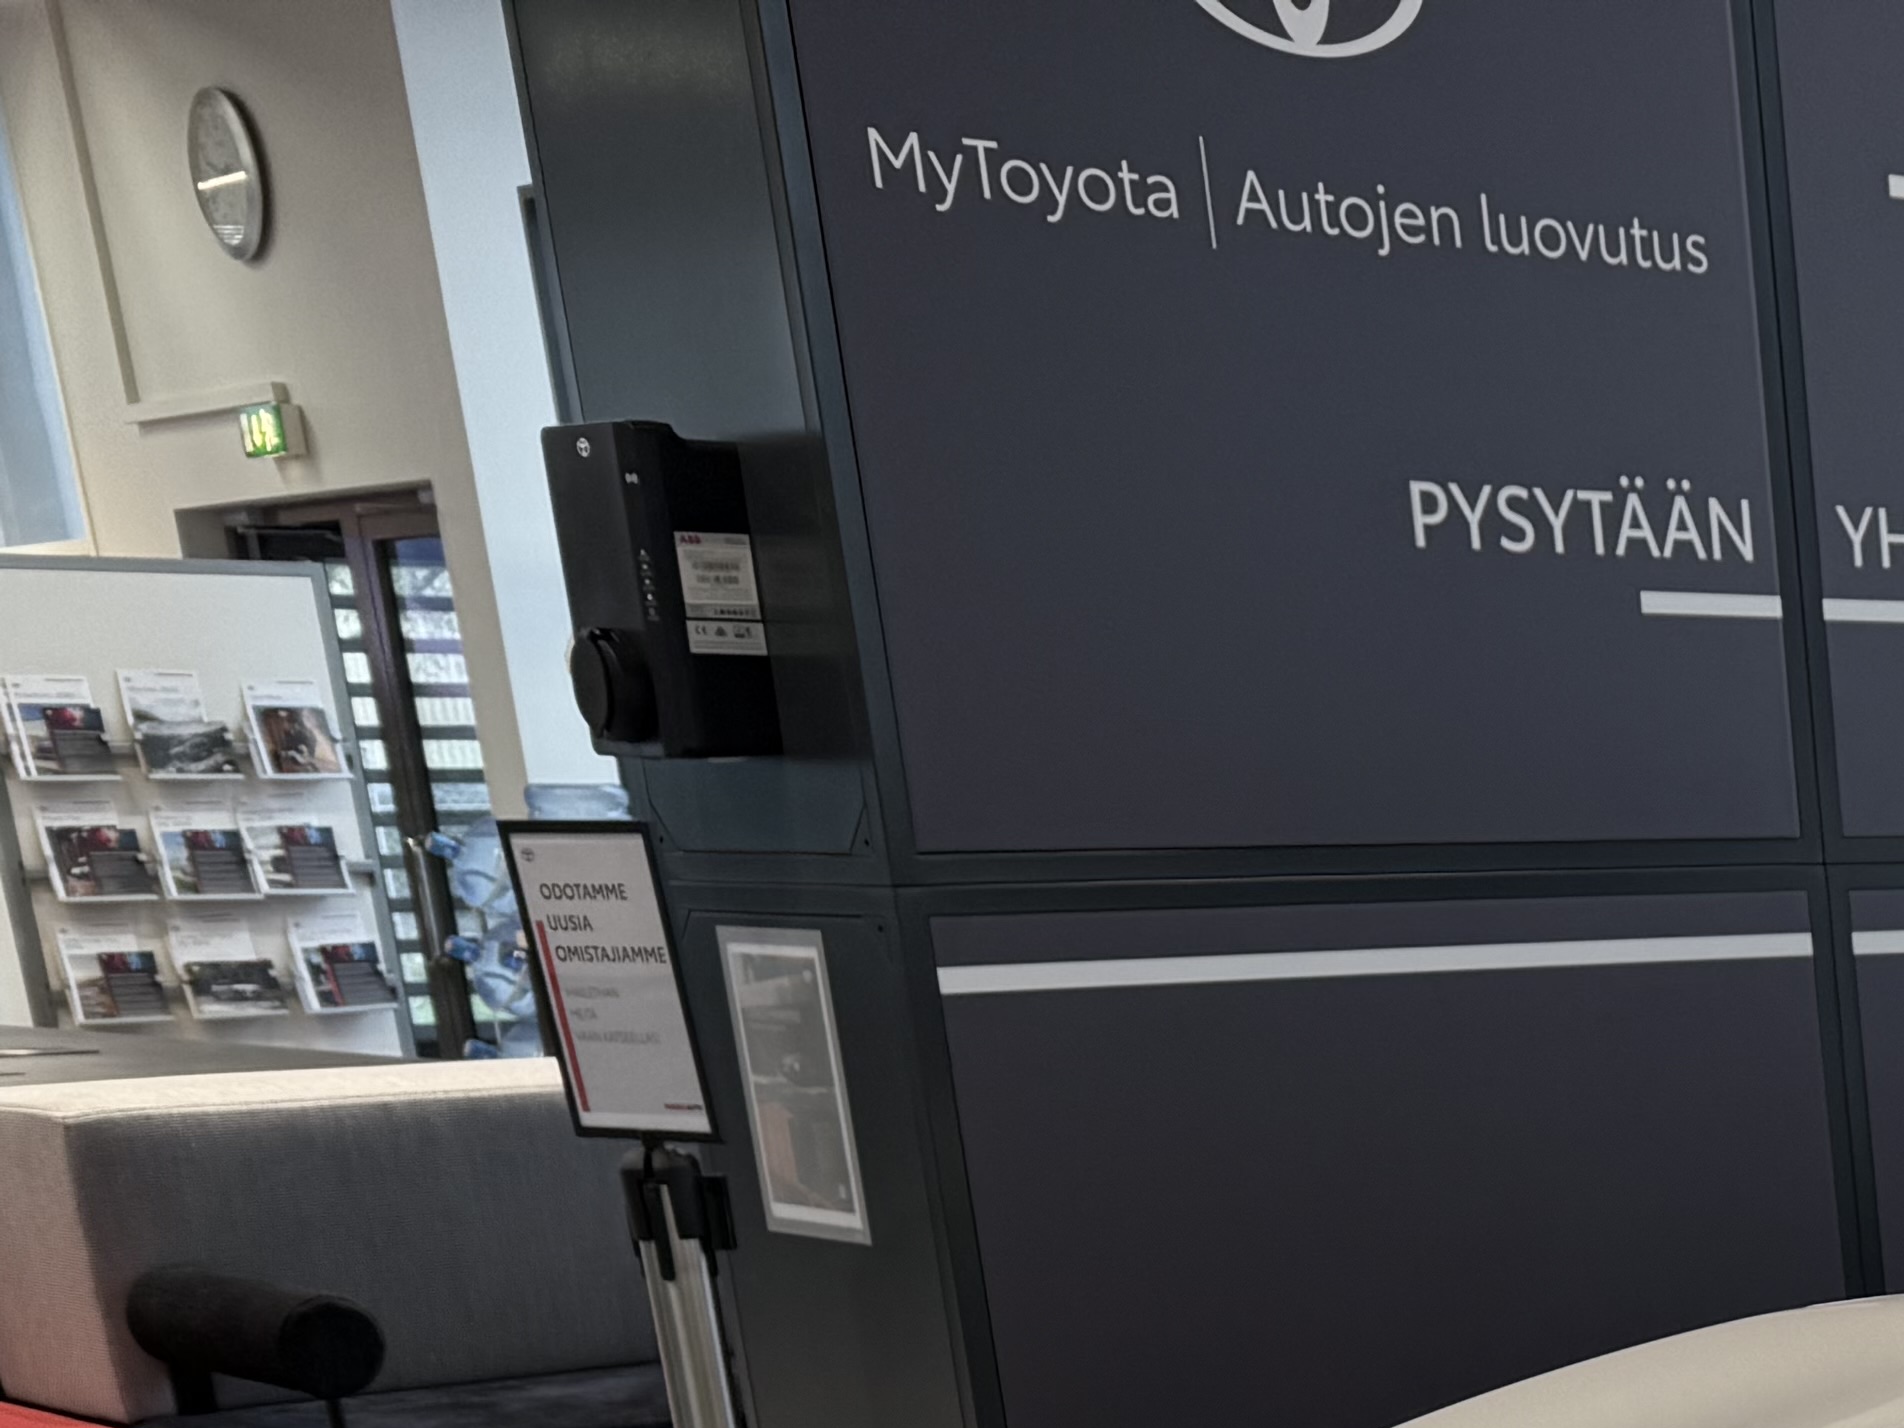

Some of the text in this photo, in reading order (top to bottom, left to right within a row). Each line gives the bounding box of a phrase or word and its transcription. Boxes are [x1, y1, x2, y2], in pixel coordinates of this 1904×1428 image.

[867, 126, 1709, 274] MyToyota Autojen luovutus
[1409, 475, 1754, 563] PYSYTÄÄN
[539, 882, 629, 901] ODOTAMME
[546, 913, 594, 932] UUSIA
[554, 944, 668, 965] OMISTAJIAMME
